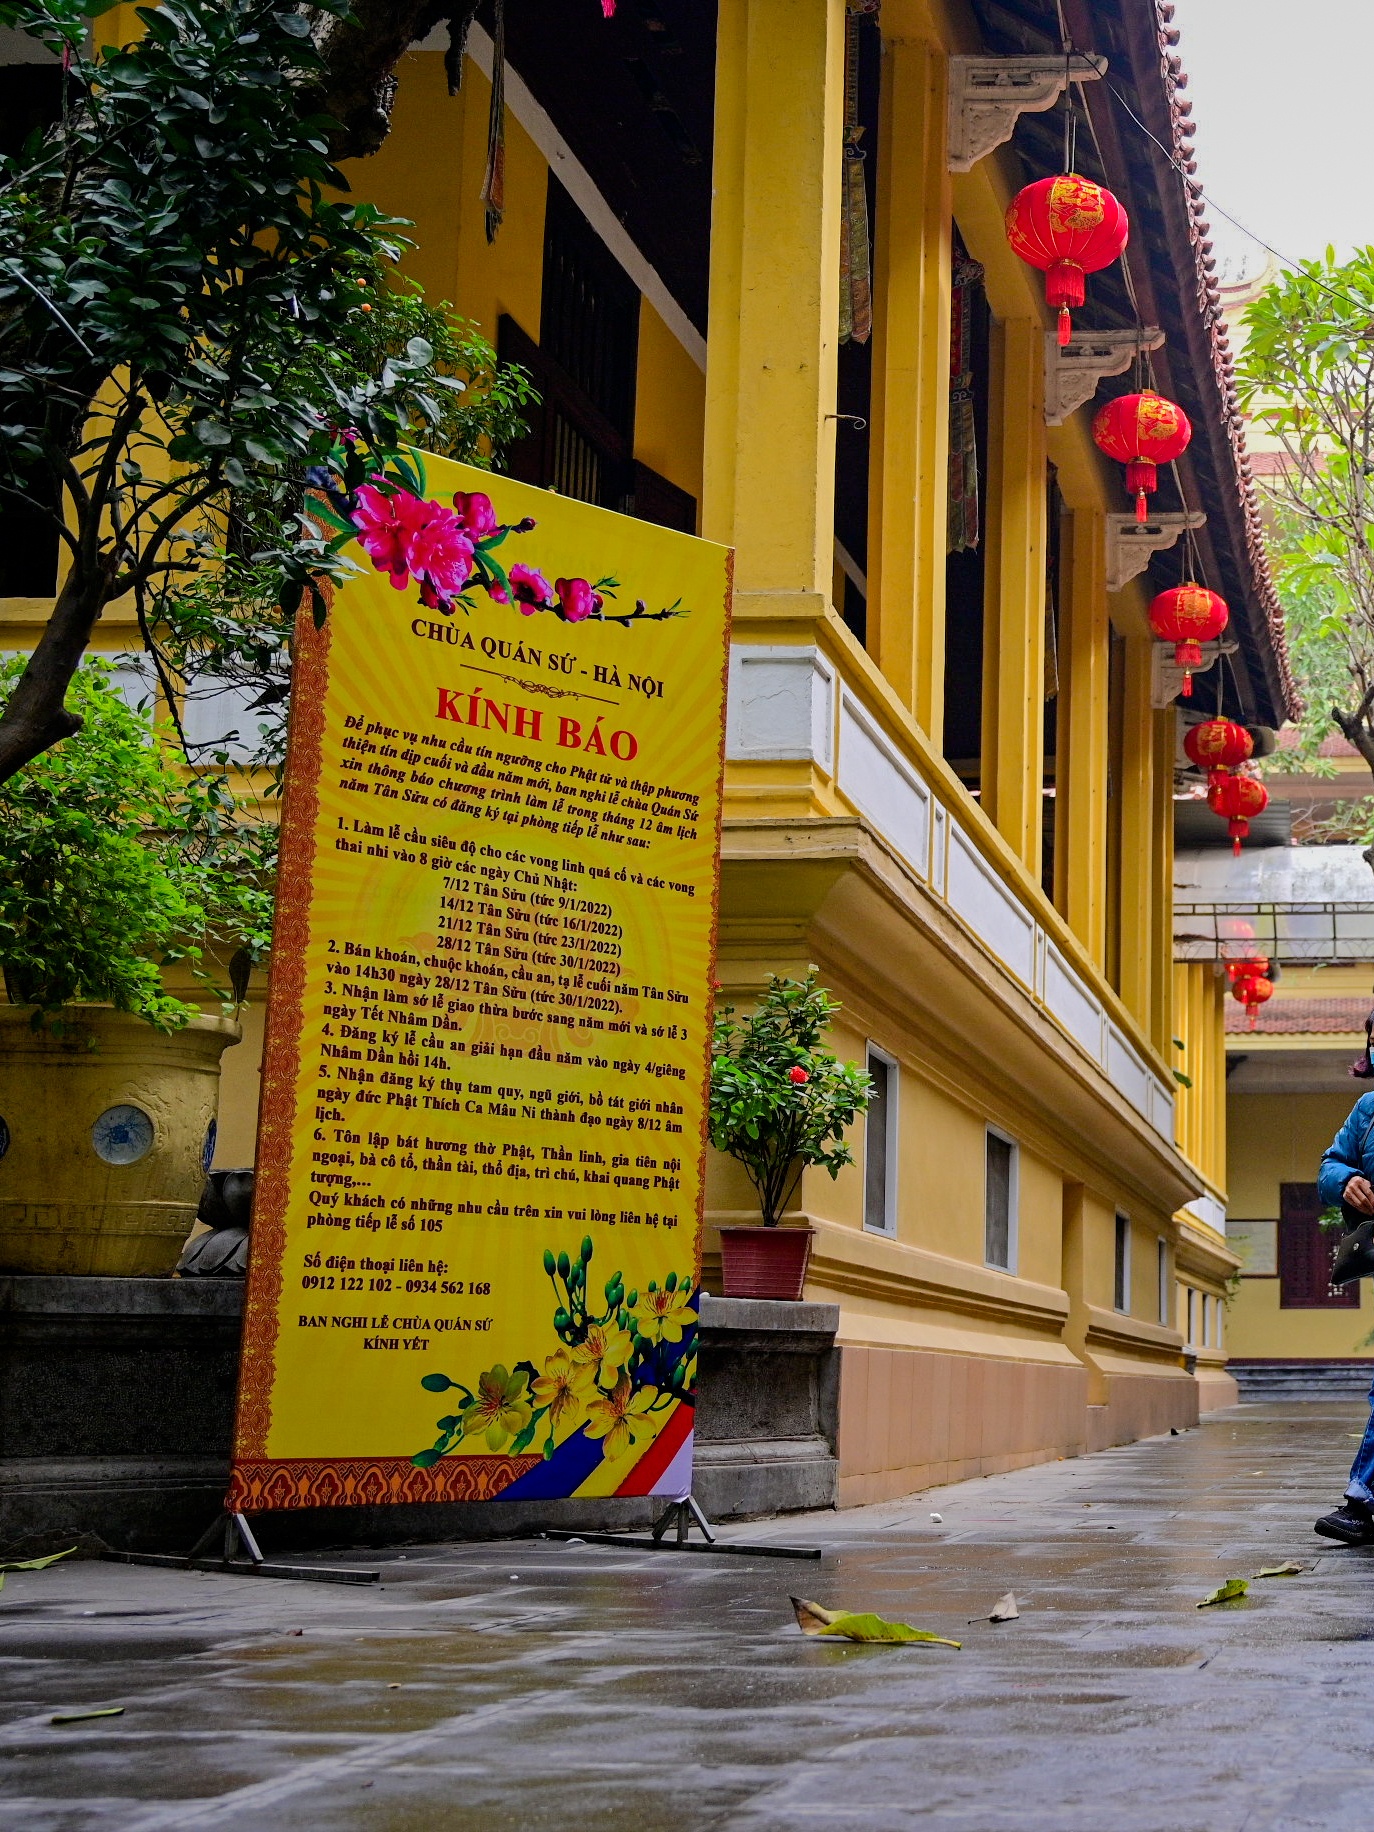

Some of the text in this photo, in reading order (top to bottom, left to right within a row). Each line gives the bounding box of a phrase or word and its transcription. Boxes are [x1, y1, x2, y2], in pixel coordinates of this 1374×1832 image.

[411, 618, 476, 651] CHÙA
[480, 636, 543, 667] QUÁN
[548, 652, 577, 675] SỨ
[593, 664, 622, 688] HÀ
[627, 673, 664, 699] NỘI
[434, 686, 639, 762] KÍNH BÁO
[342, 736, 700, 822] thiện tín dịp cuối và đầu năm mới, ban nghi lễ chùa Quán Sứ
[344, 714, 700, 807] Để phục vụ nhu cầu tín ngưỡng cho Phật tử và thập phương
[335, 837, 578, 894] thai nhi vào 8 giờ các ngày Chủ Nhật:
[338, 816, 695, 898] 1. Làm lễ cầu siêu độ cho các vong linh quá cố và các vong
[440, 895, 623, 940] 14/12 Tân Sửu (tức 16/1/2022)
[442, 876, 613, 920] 7/12 Tân Sửu (tức 9/1/2022)
[436, 935, 621, 978] 28/12 Tân Sửu (tức 30/1/2022)
[437, 915, 622, 959] 21/12 Tân Sửu (tức 23/1/2022)
[312, 1150, 680, 1192] ngoại, bà cô tổ, thần tài, thổ địa, trì chú, khai quang Phật
[313, 1127, 681, 1174] 6. Tôn lập bát hương thờ Phật, Thần linh, gia tiên nội
[310, 1170, 371, 1189] tượng,...
[306, 1211, 443, 1233] phòng tiếp lễ số 105
[308, 1190, 678, 1230] Quý khách có những nhu cầu trên xin vui lòng liên hệ tại
[301, 1275, 335, 1290] 0912
[340, 1277, 364, 1291] 122
[369, 1278, 392, 1292] 102
[405, 1279, 437, 1294] 0934
[440, 1280, 464, 1295] 562
[468, 1282, 491, 1296] 168
[303, 1250, 449, 1277] Số điện thoại liên hệ:
[298, 1315, 328, 1328] BAN
[331, 1316, 368, 1329] NGHI
[392, 1315, 431, 1330] CHÙA
[433, 1316, 472, 1333] QUÁN
[474, 1317, 494, 1332] SỨ
[363, 1334, 400, 1350] KÍNH
